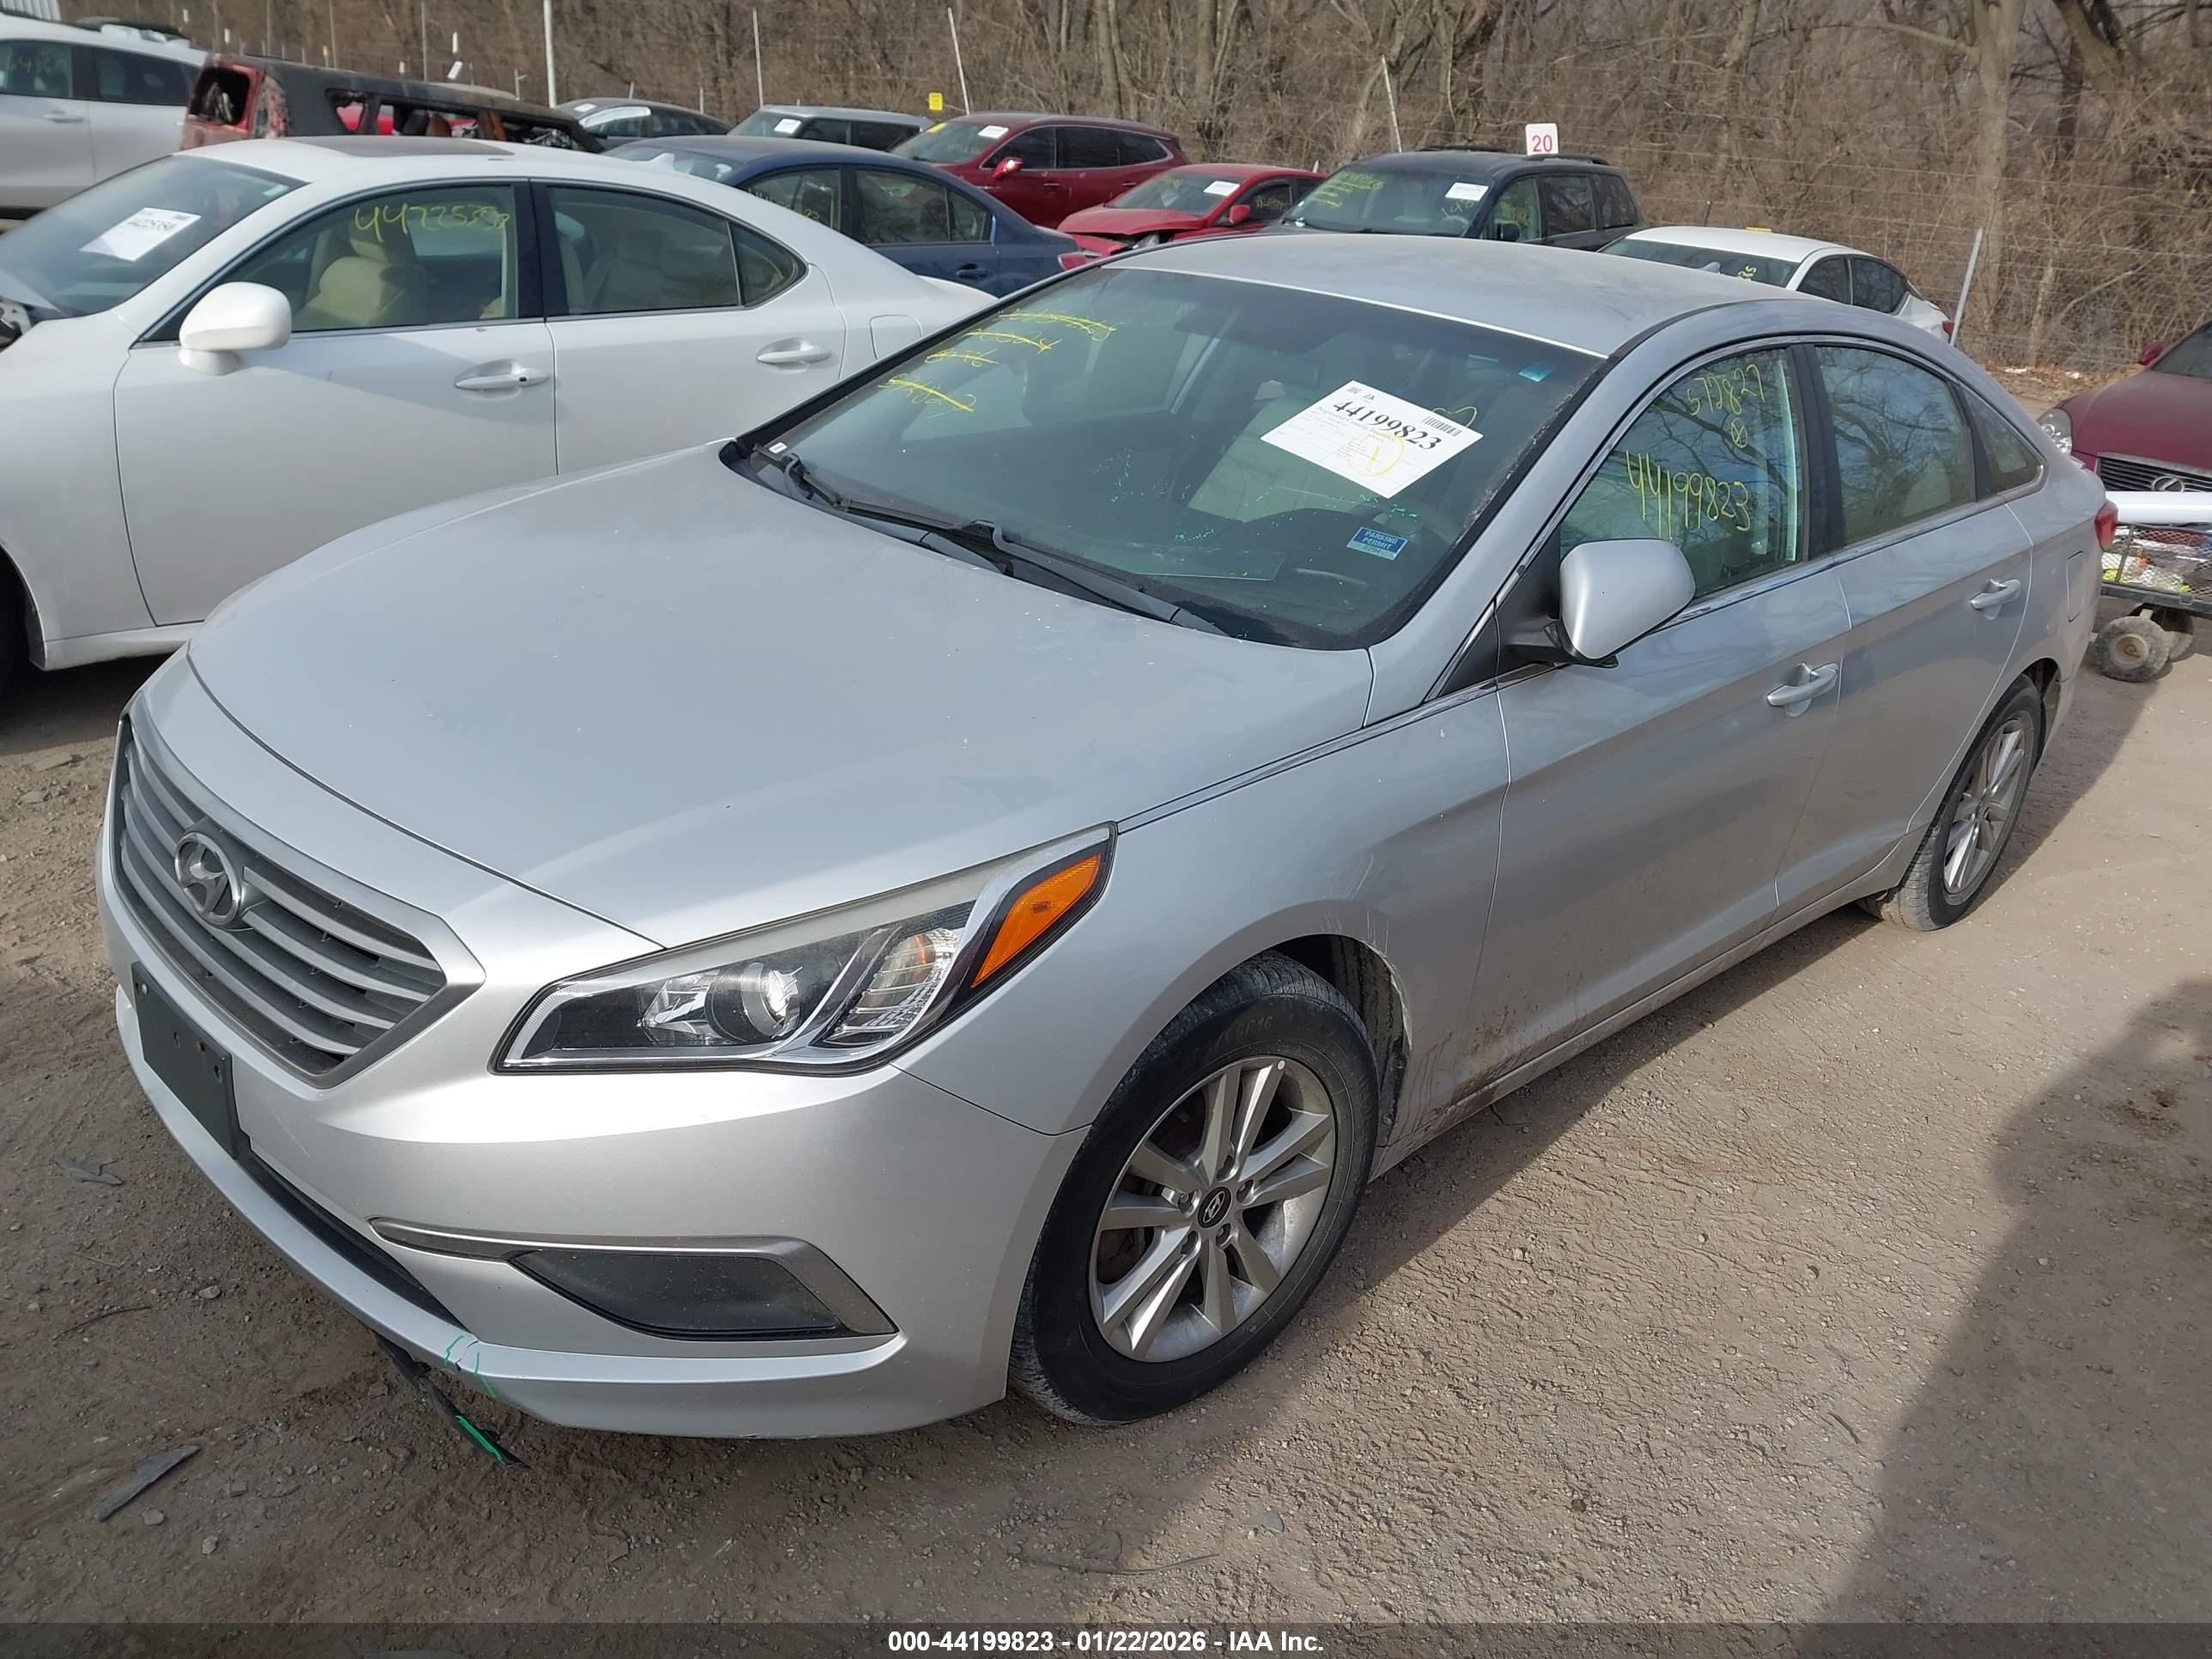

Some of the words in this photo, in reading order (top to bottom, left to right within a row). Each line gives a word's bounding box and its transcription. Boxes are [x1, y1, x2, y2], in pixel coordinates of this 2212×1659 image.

[1532, 135, 1553, 153] 20
[1332, 401, 1443, 451] 44199823
[1626, 449, 1752, 541] 44199823
[1361, 537, 1393, 550] PERMIT
[1364, 530, 1399, 545] PARKING
